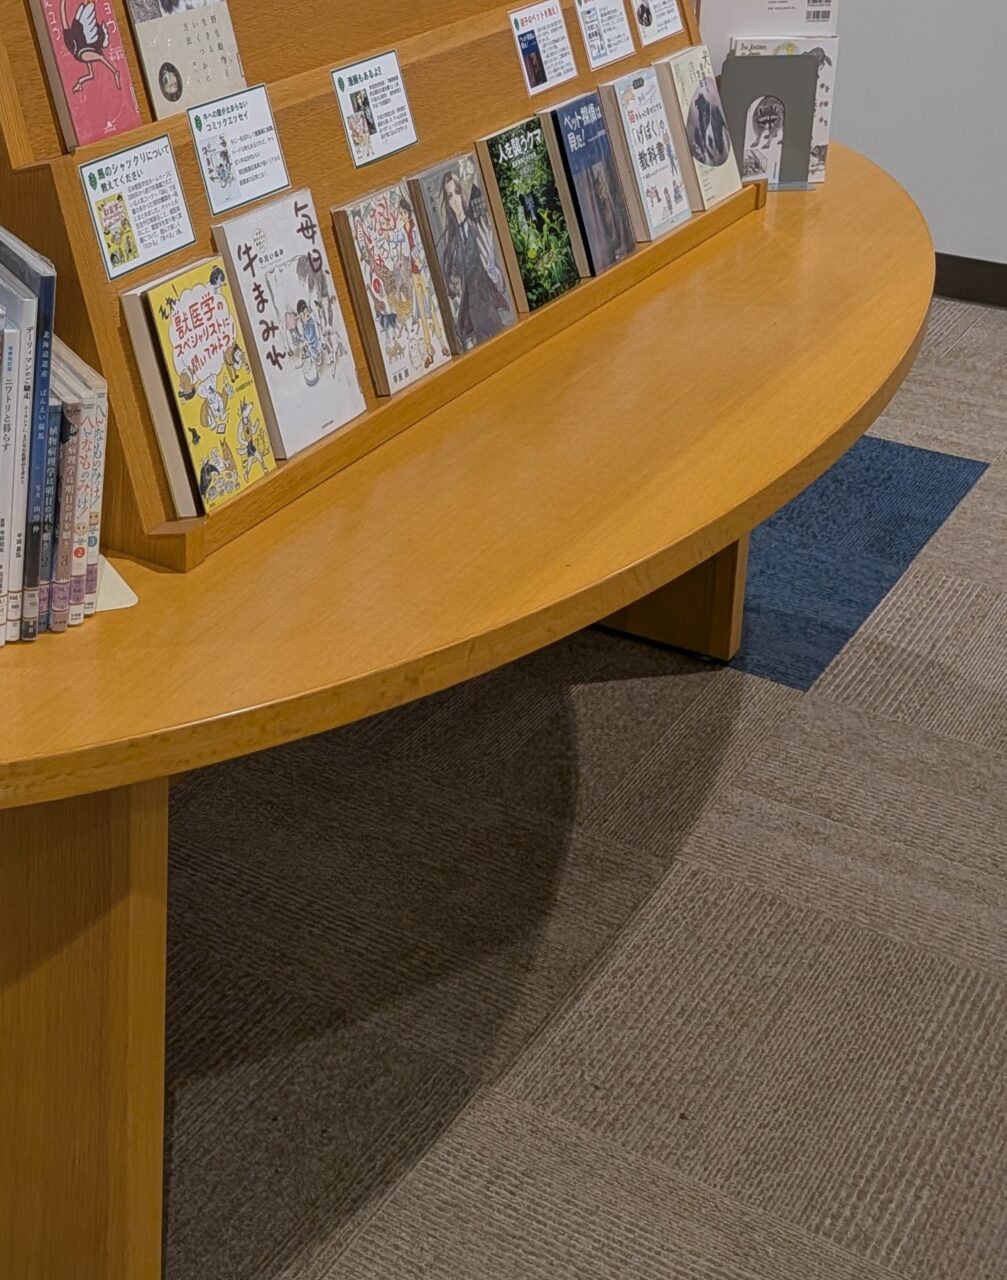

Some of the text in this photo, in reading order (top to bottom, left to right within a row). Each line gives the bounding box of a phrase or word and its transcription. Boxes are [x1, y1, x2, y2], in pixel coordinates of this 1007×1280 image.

[206, 111, 249, 132] コミックエッセイ
[564, 103, 602, 131] ペット探偵は
[97, 144, 169, 180] 馬のシャックリについて
[498, 129, 541, 164] 人を襲うクマ
[638, 141, 666, 171] 教科書
[101, 169, 144, 193] 教えてください
[172, 293, 224, 340] 獣医学の
[237, 242, 289, 371] 牛まみれ
[174, 316, 232, 358] スペシャリストに
[2, 379, 13, 451] ニワトリと暮らす
